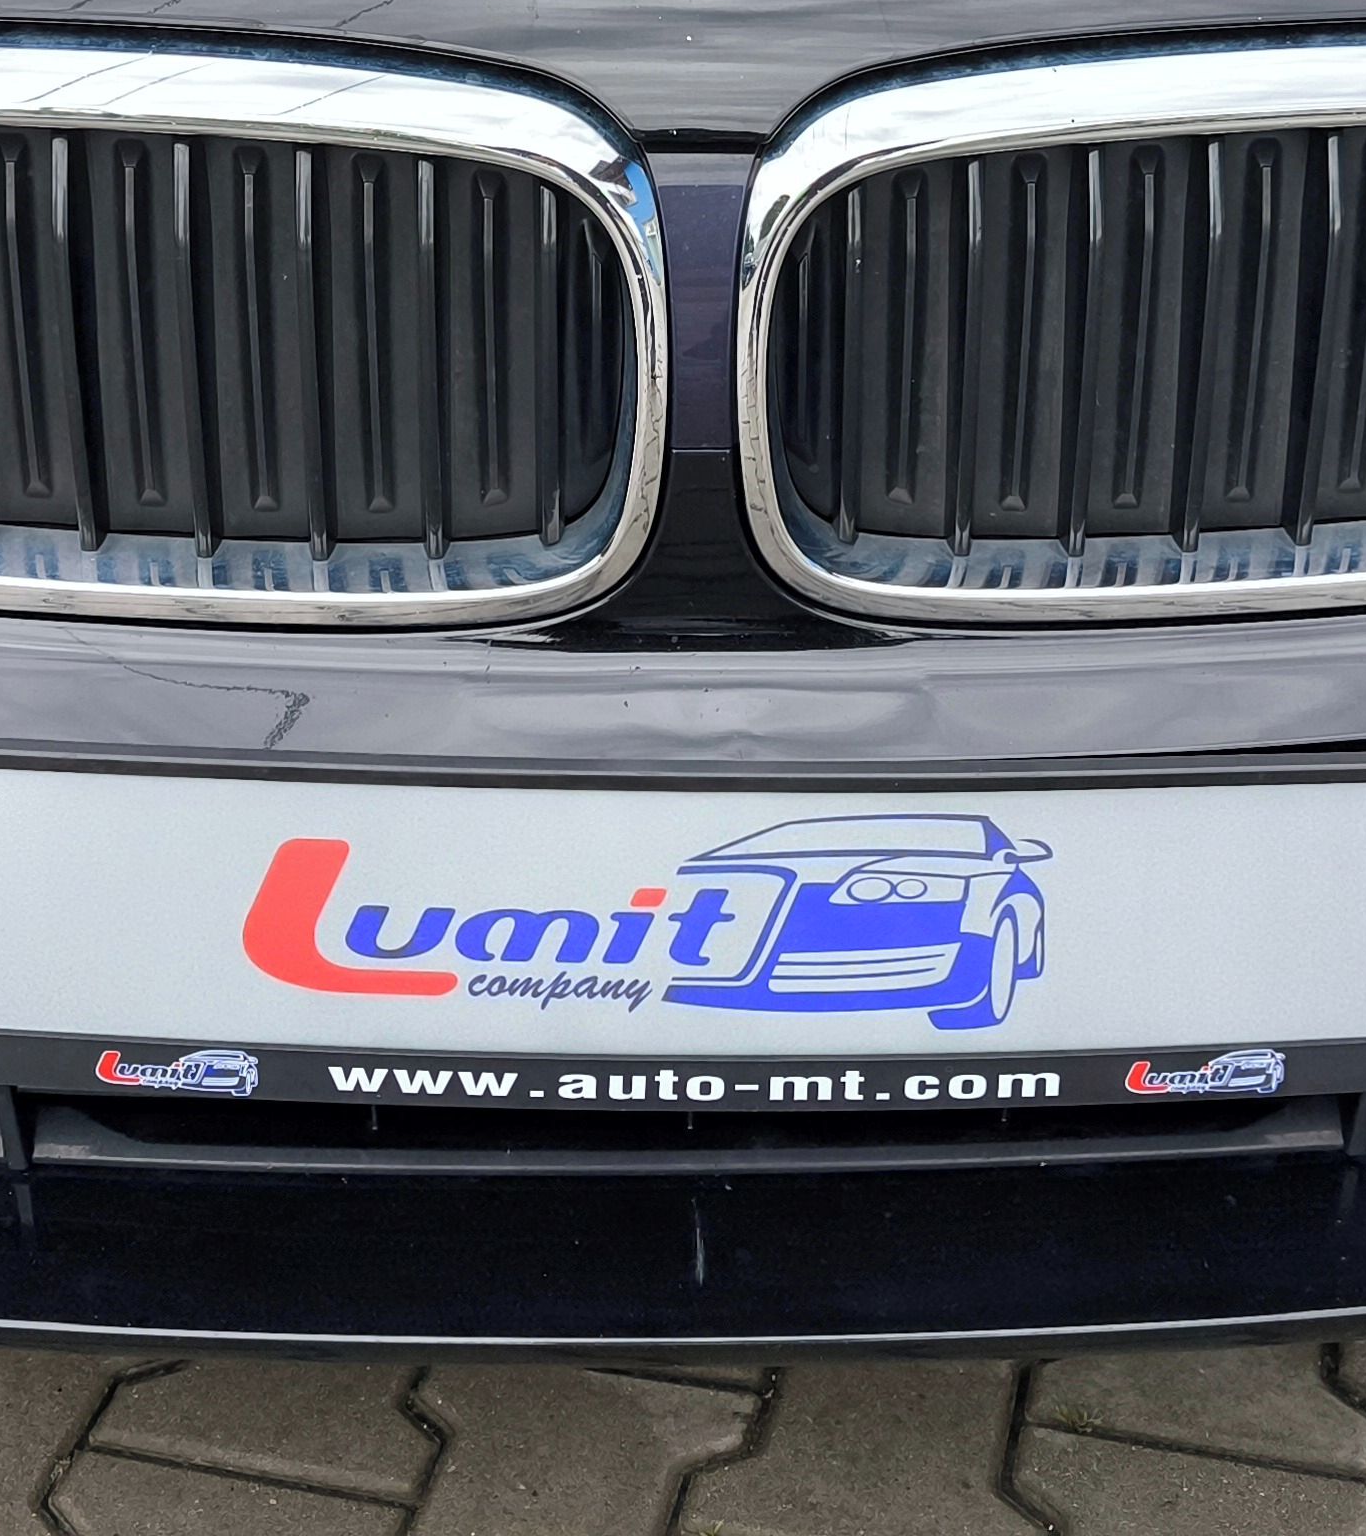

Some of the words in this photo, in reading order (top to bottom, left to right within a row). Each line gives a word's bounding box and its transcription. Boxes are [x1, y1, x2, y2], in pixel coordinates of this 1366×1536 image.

[243, 838, 736, 996] Lumit
[467, 970, 653, 1012] company
[96, 1051, 201, 1085] Lumit
[328, 1066, 1061, 1102] www.auto-mt.com
[1125, 1062, 1227, 1094] Lumit
